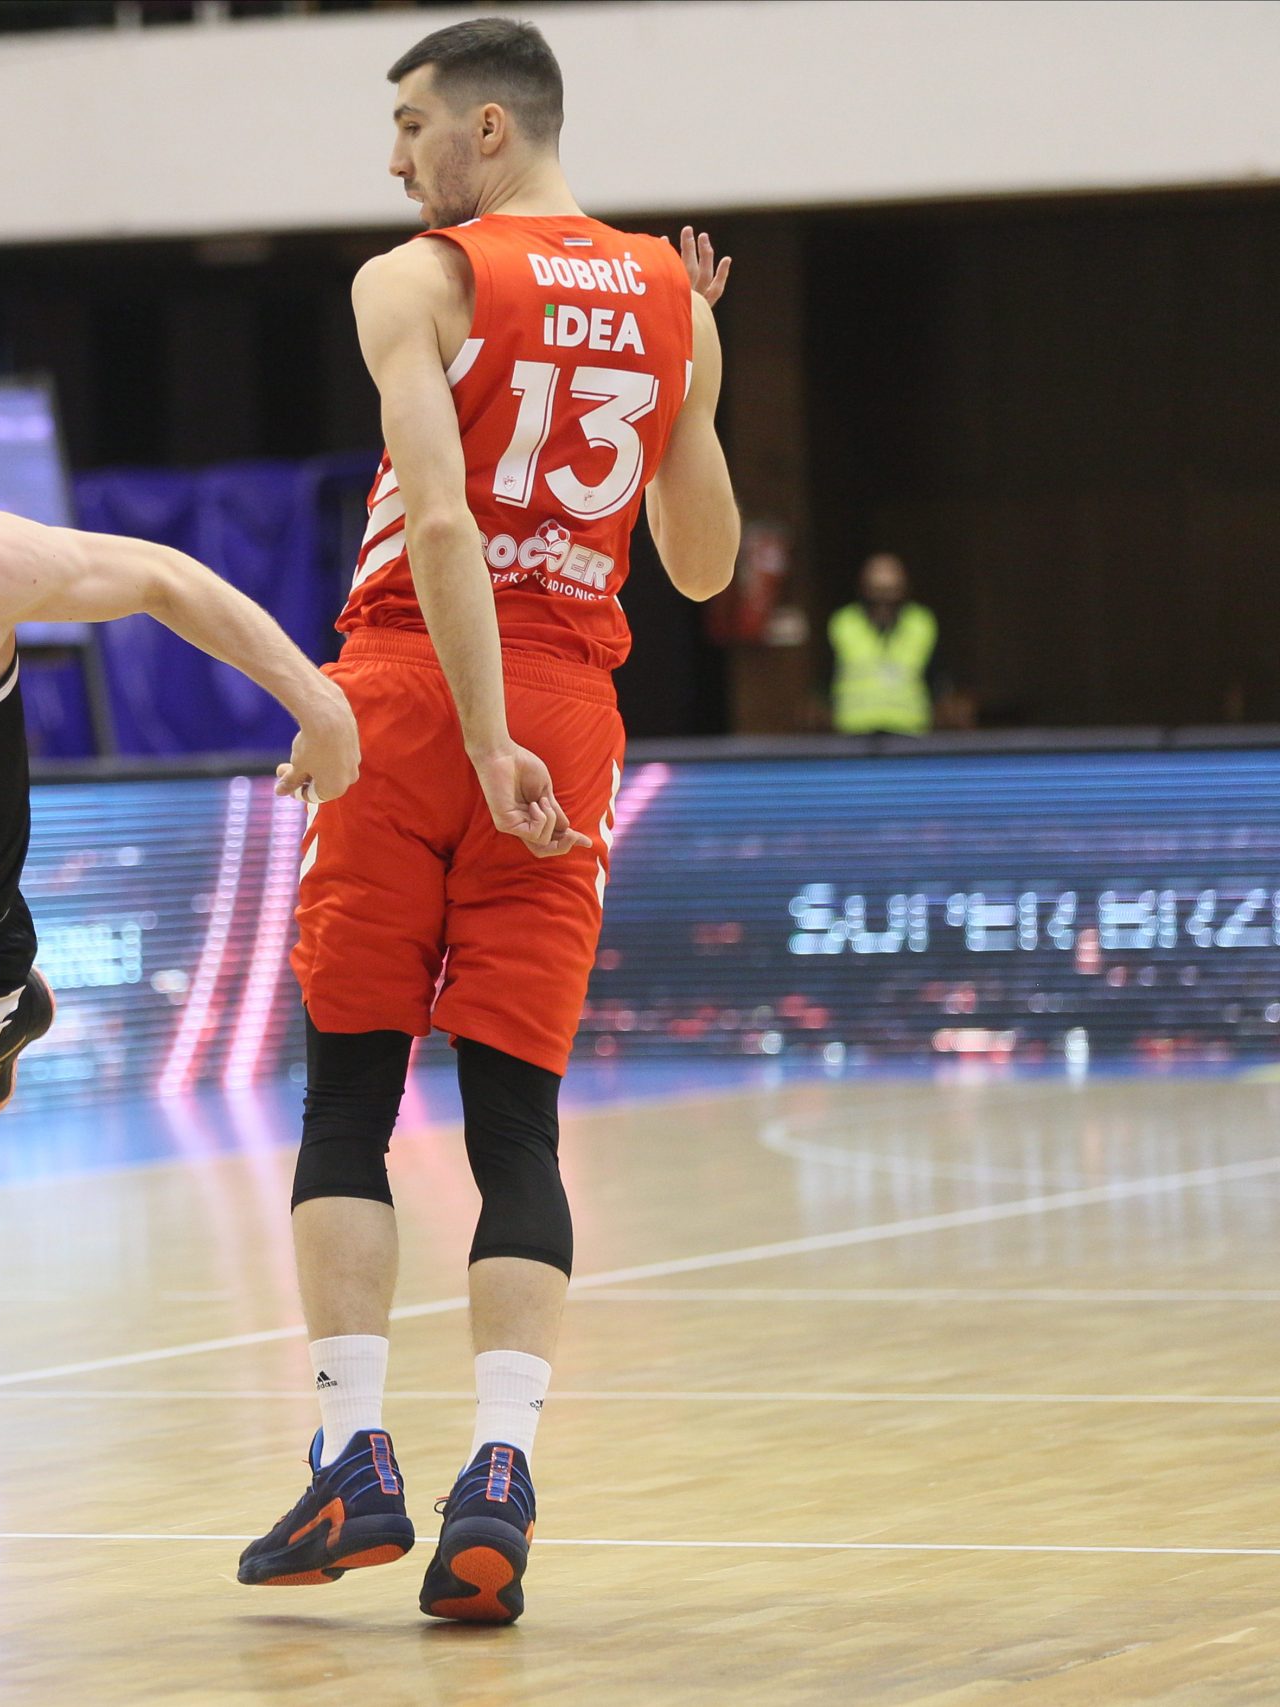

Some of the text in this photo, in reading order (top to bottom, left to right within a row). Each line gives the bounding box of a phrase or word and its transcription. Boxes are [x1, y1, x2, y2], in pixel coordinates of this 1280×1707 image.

[527, 252, 646, 296] DOBRIĆ
[491, 360, 660, 521] 13
[492, 571, 528, 584] TSKA
[1098, 880, 1280, 951] BRZ
